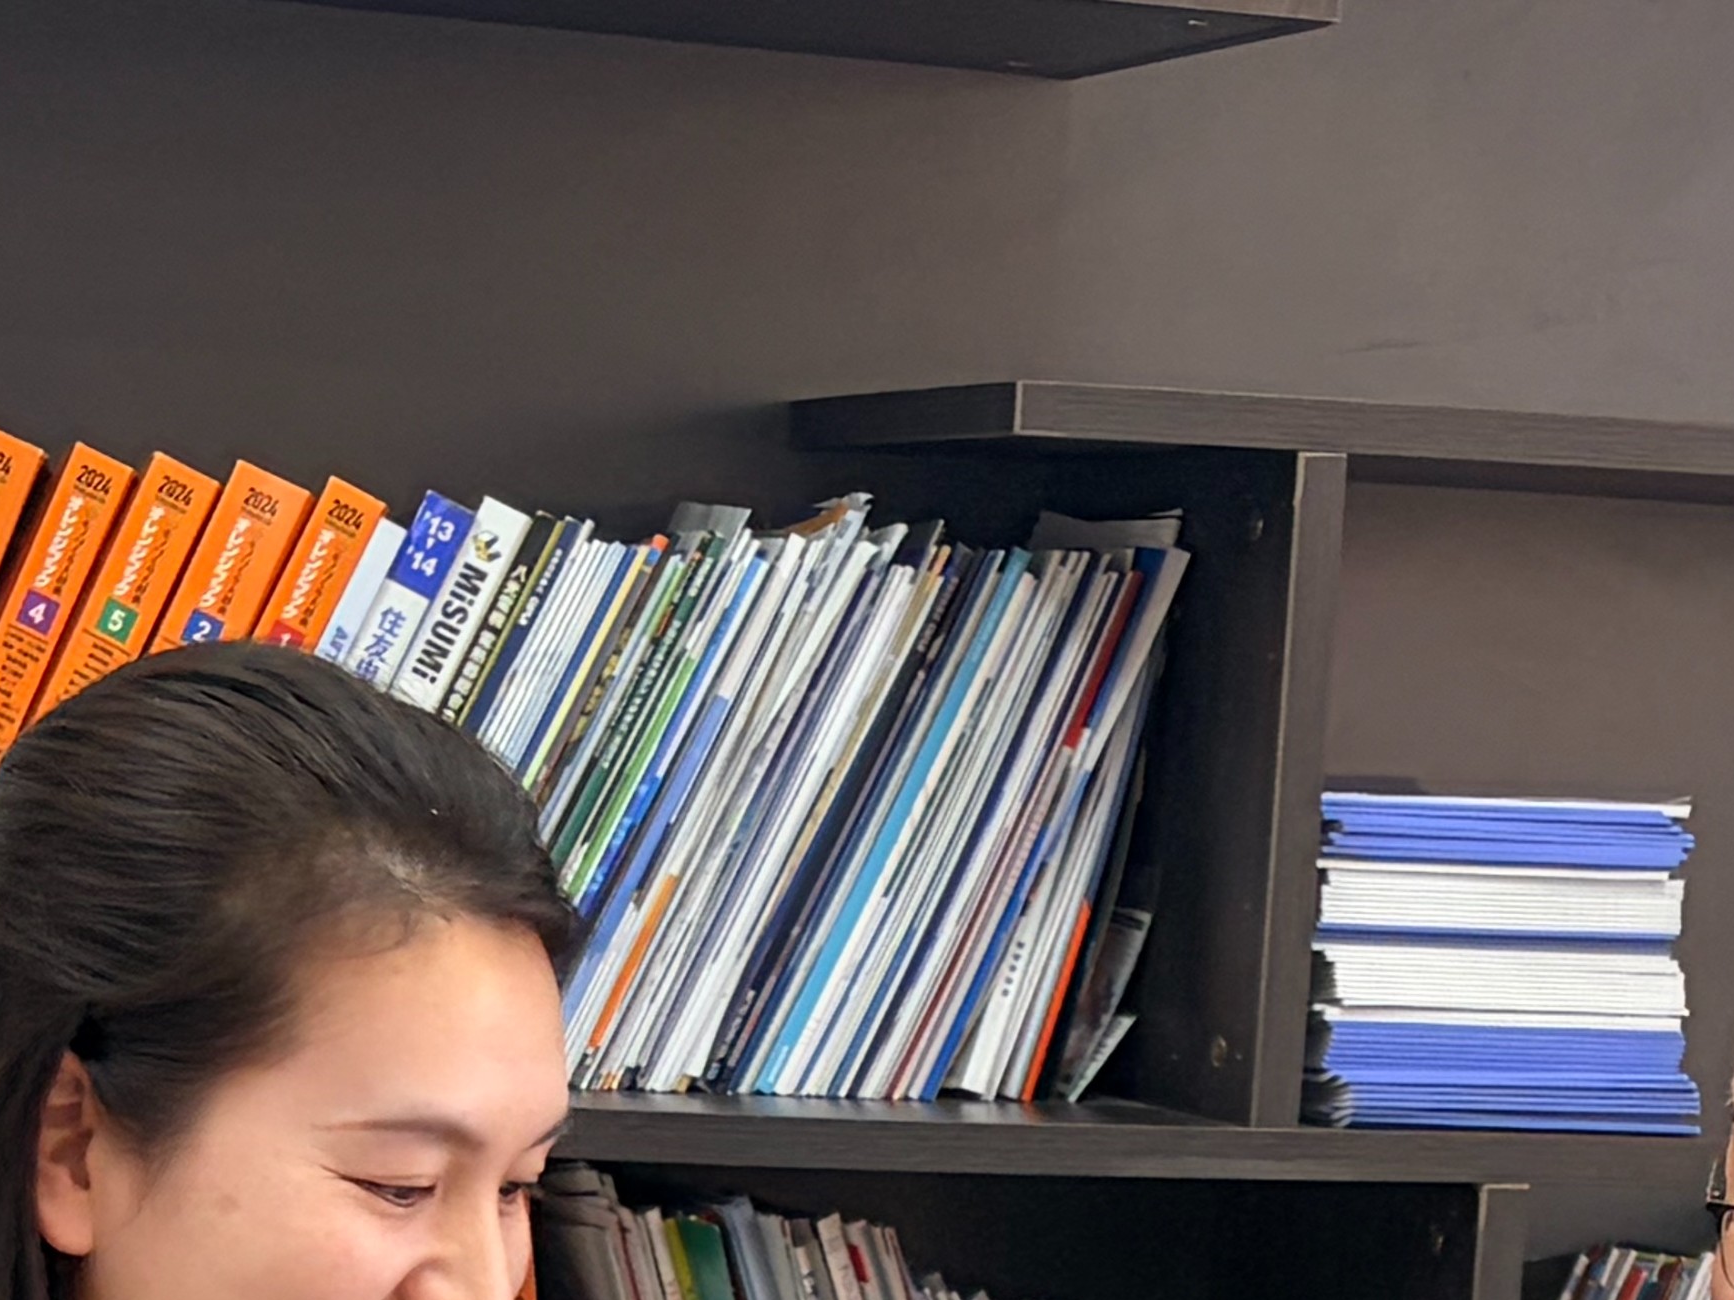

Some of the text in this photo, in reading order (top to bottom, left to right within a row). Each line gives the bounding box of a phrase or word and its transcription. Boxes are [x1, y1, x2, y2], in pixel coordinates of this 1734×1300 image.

[76, 464, 112, 496] 2024
[156, 476, 194, 507] 2024
[243, 487, 279, 518] 2024
[327, 498, 365, 530] 2024
[28, 603, 47, 624] 4
[107, 608, 127, 631] 5
[192, 621, 212, 642] 2
